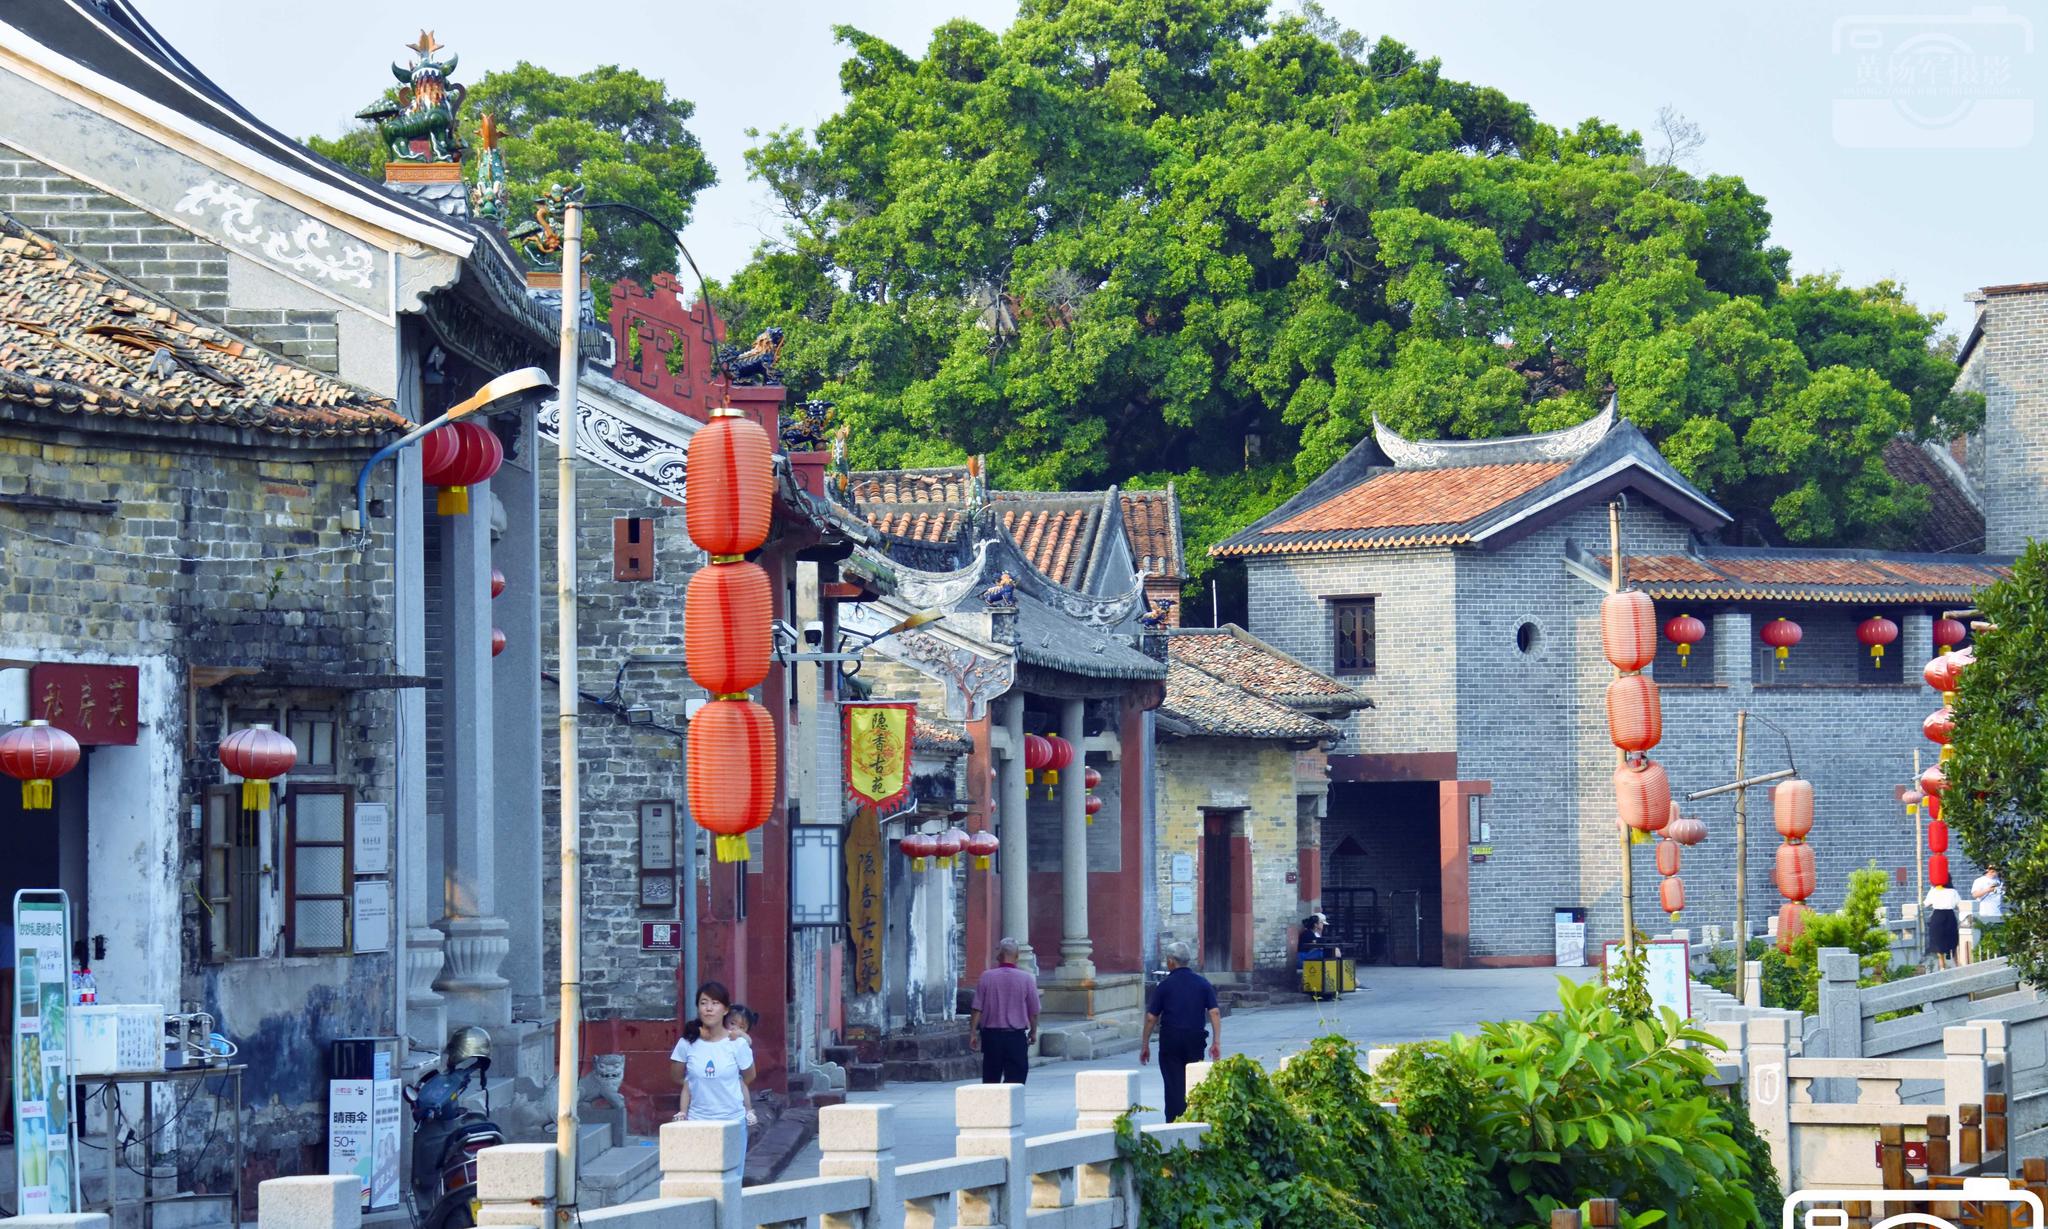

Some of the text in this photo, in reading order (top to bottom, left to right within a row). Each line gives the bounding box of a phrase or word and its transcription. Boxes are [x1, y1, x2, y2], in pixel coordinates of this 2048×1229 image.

[868, 711, 888, 794] 隐香古苑
[333, 1111, 368, 1124] 晴雨伞
[333, 1136, 356, 1147] 50+
